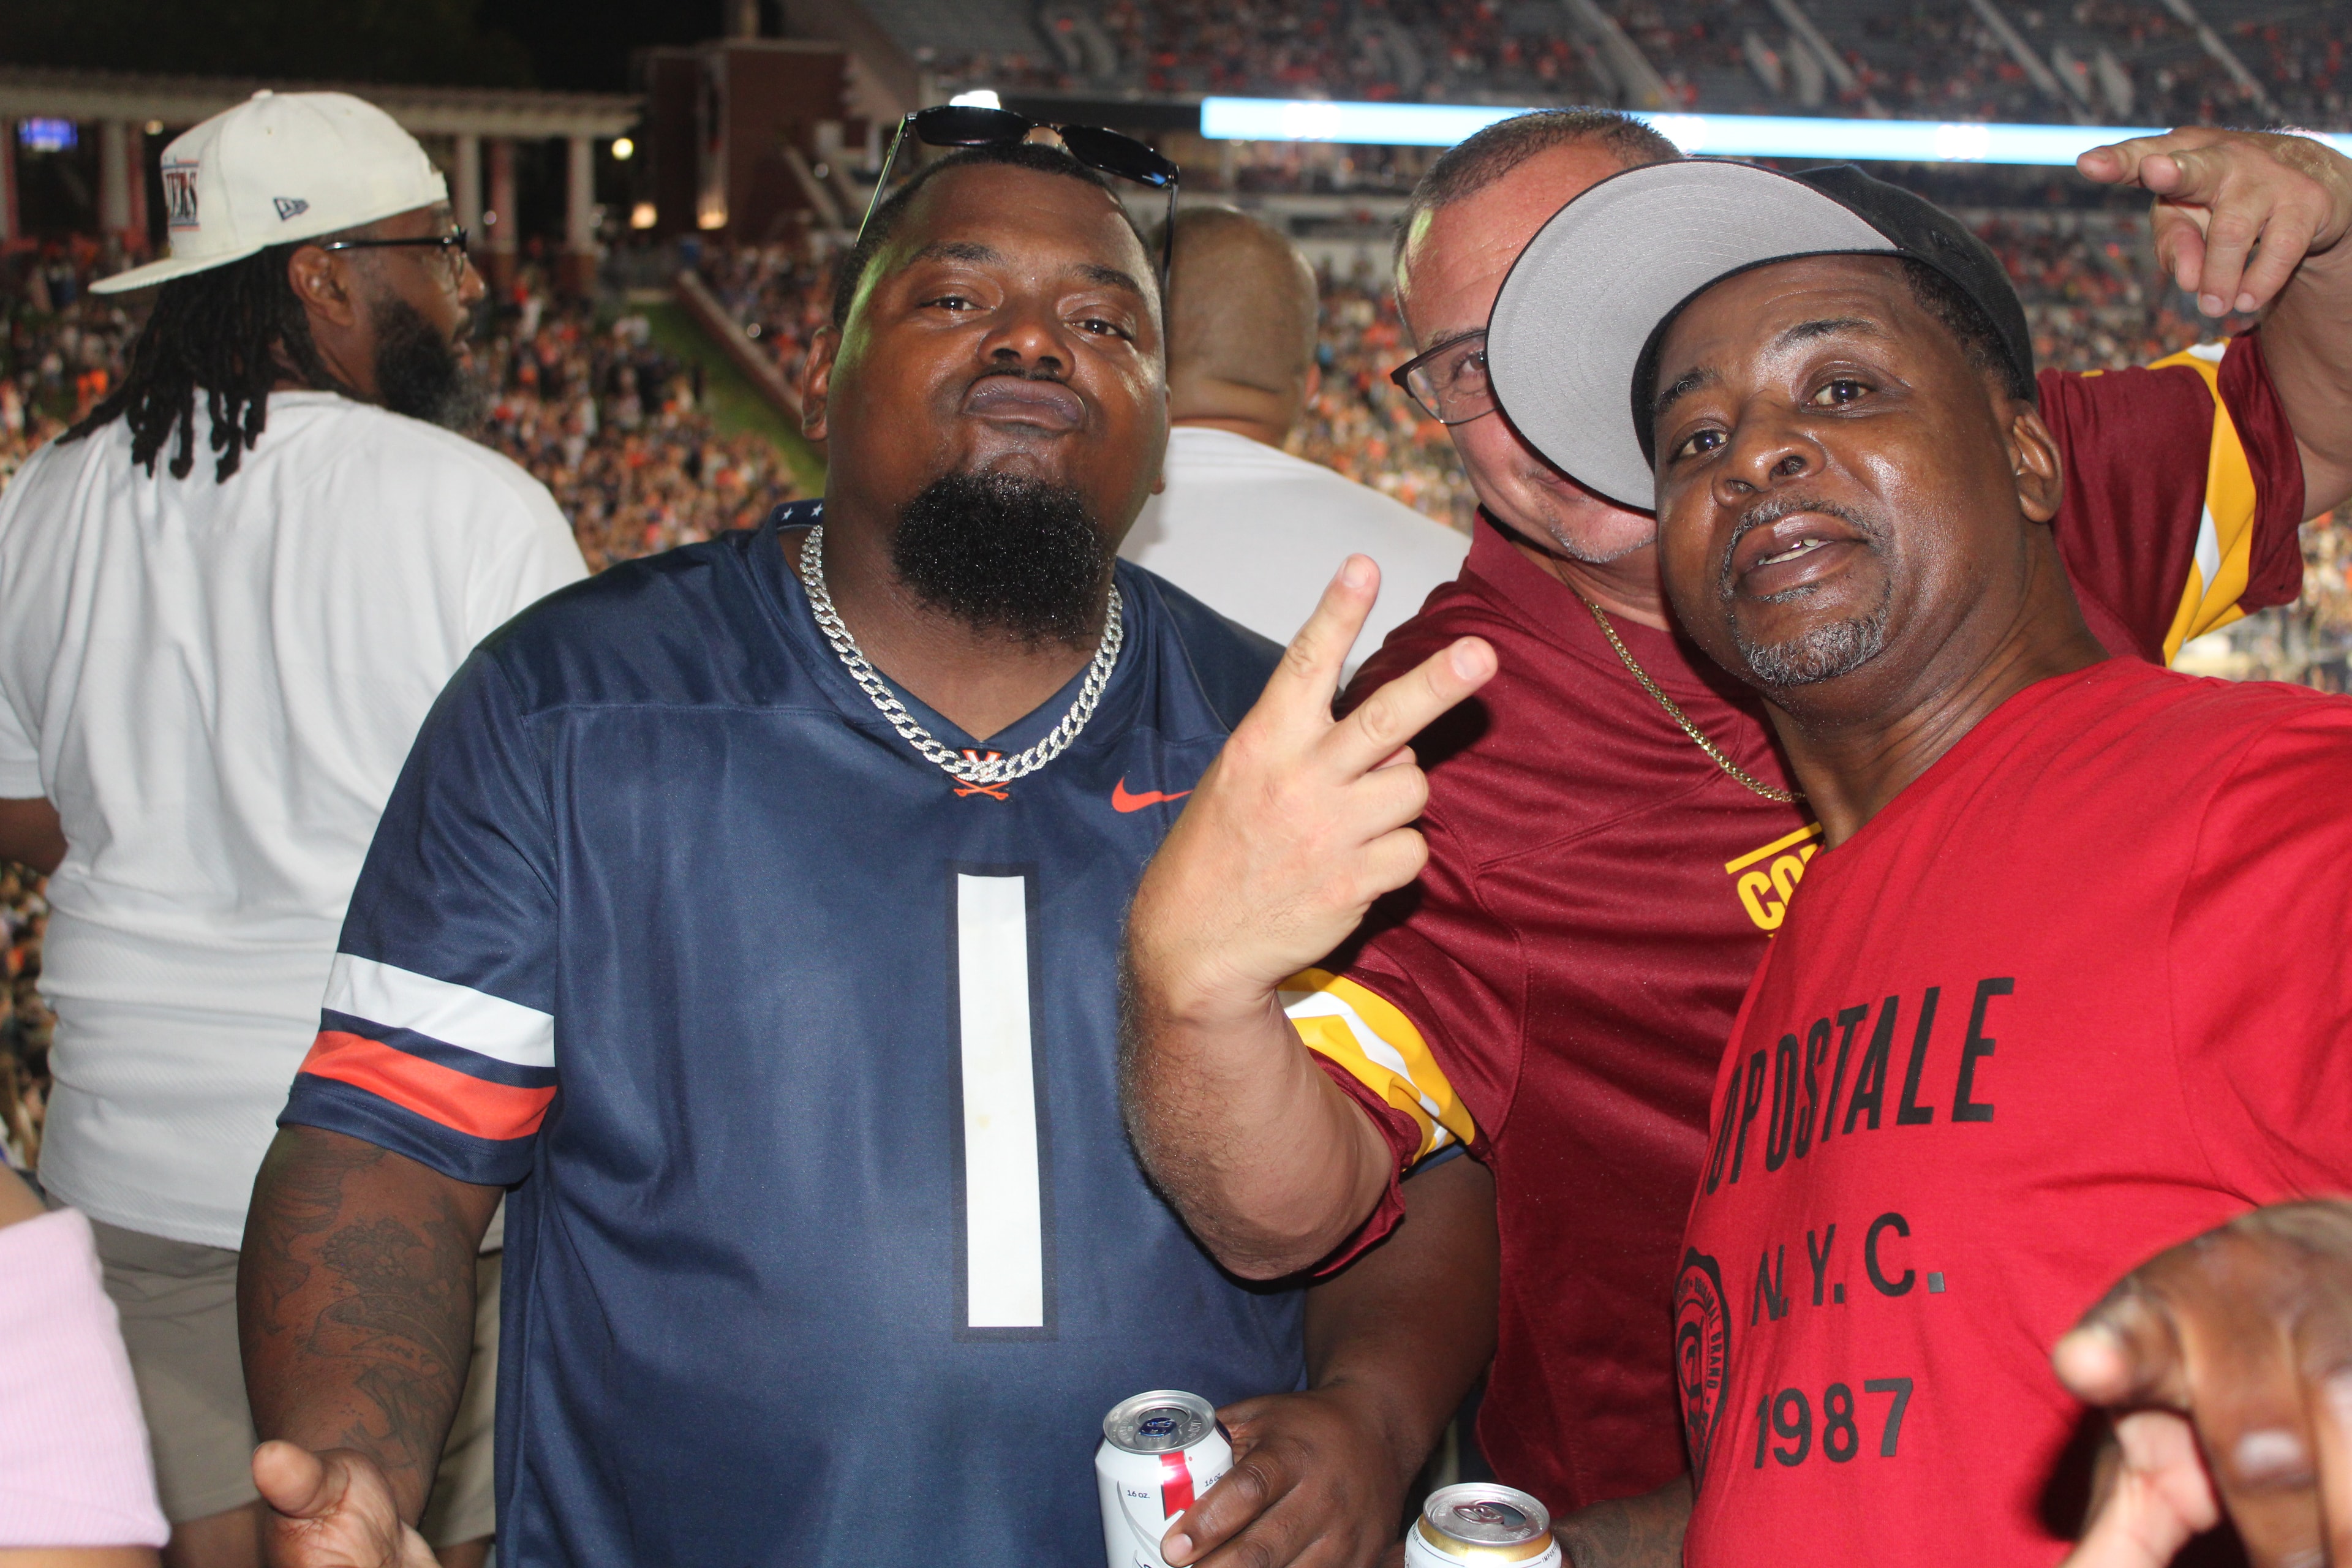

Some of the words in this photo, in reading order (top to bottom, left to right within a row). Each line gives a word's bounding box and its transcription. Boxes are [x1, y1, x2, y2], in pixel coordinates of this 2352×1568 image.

[1737, 843, 1819, 930] CO
[957, 872, 1044, 1328] 1
[1754, 1378, 1913, 1469] 1987
[1205, 1479, 1213, 1487] 16
